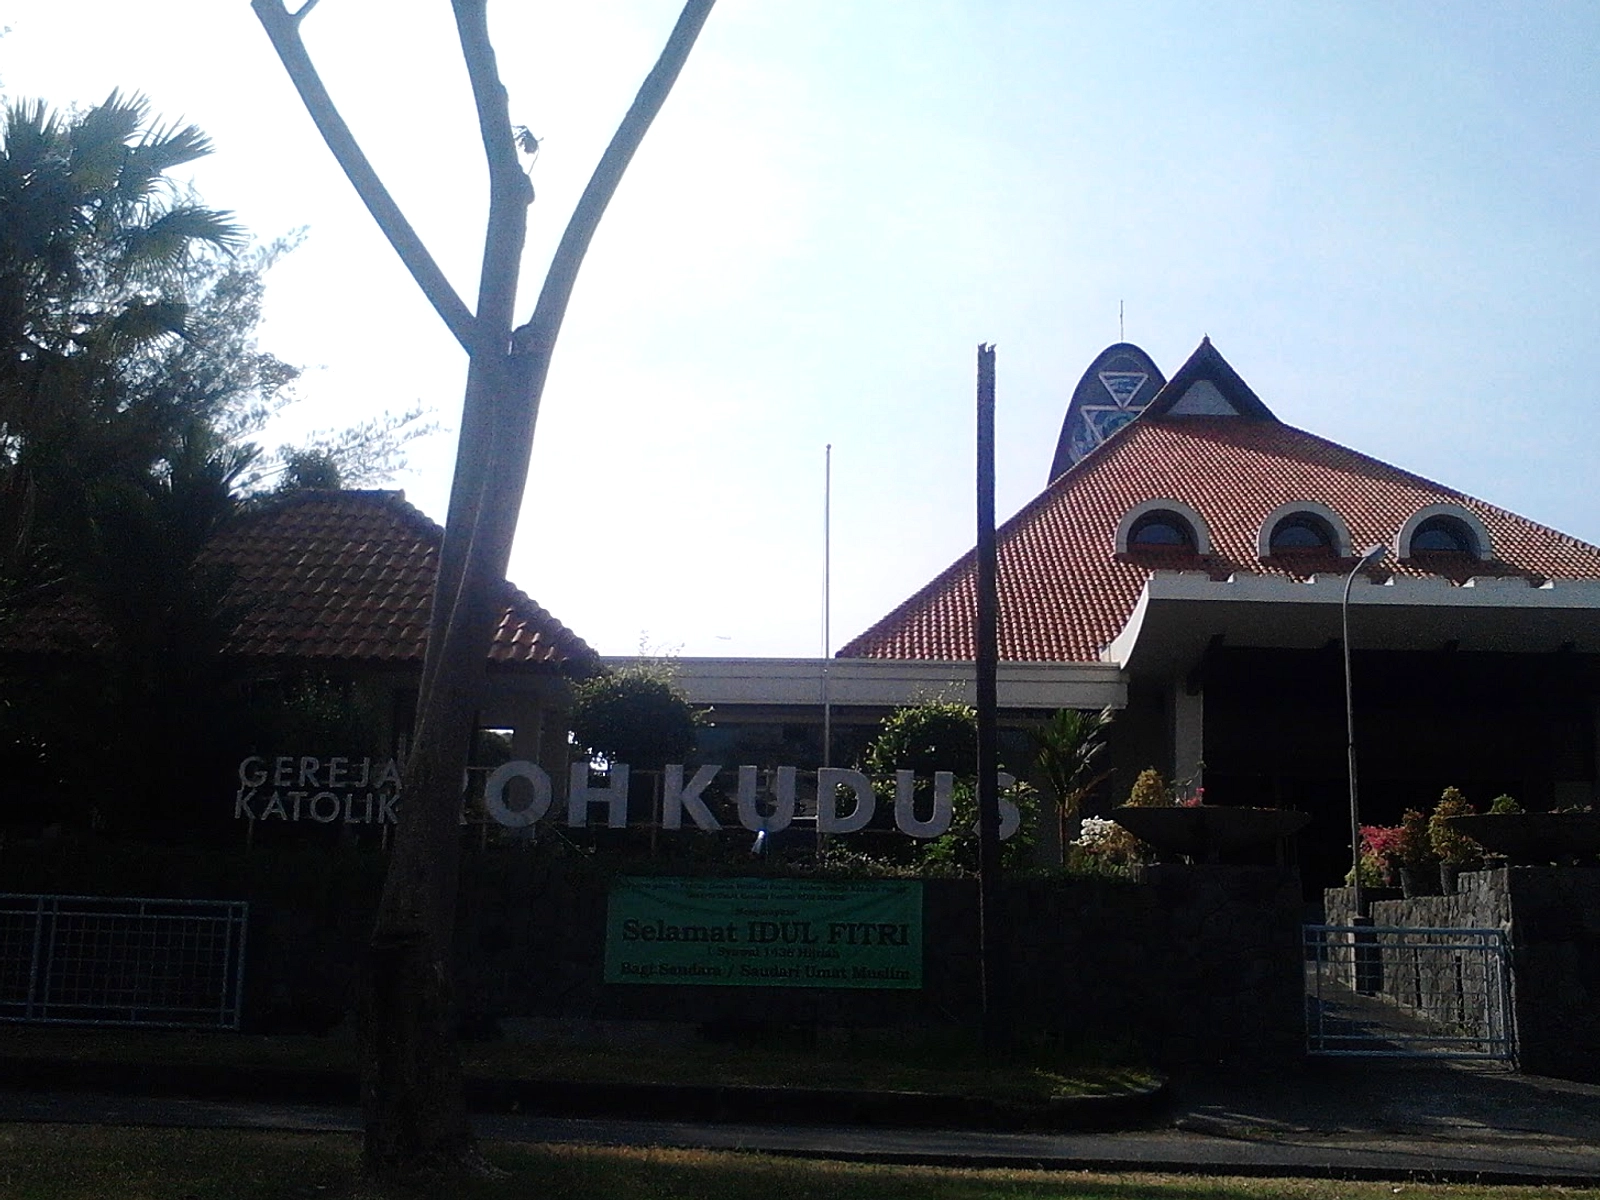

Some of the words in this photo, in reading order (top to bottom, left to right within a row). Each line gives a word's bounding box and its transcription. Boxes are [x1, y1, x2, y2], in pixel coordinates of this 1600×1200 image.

[238, 756, 402, 789] GEREJA
[234, 788, 400, 825] KATOLIK
[459, 760, 631, 829] OH
[622, 918, 738, 943] Selamat
[747, 920, 819, 944] IDUL
[827, 922, 910, 946] FITRI
[740, 963, 801, 978] Saudari
[804, 964, 847, 979] Umat
[851, 966, 911, 980] Muslim
